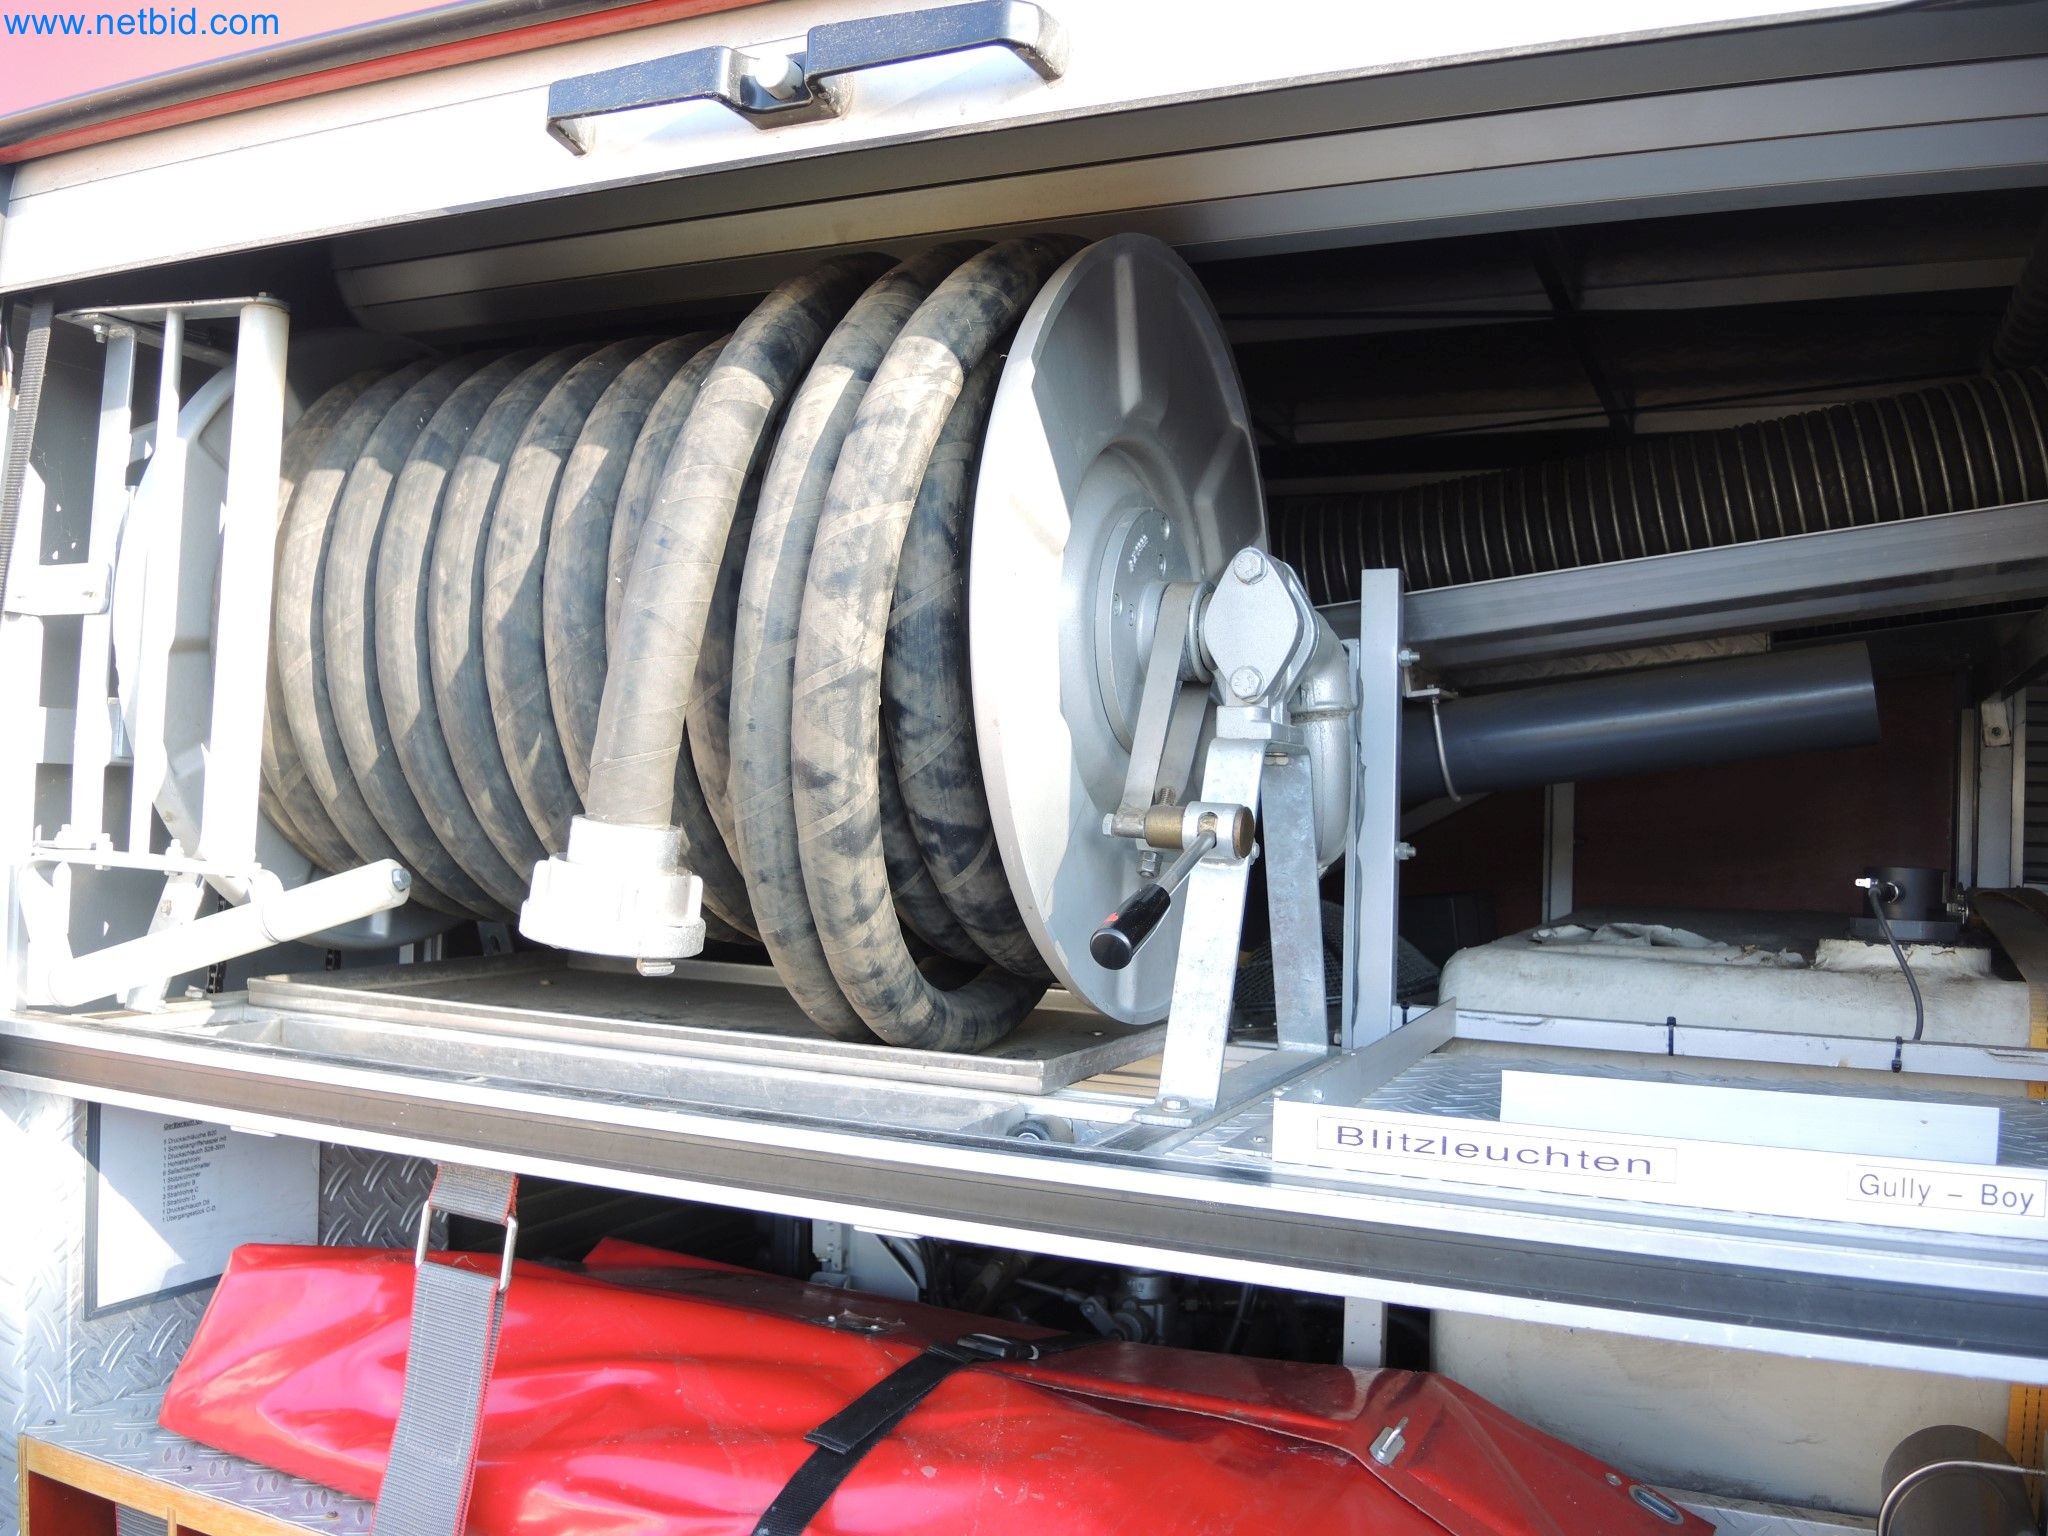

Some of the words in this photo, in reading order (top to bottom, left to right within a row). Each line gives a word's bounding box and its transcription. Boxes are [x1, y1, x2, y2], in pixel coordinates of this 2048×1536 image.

[1336, 1125, 1652, 1175] Blitzleuchten
[1859, 1173, 1931, 1207] Gully
[1981, 1183, 2034, 1216] Boy
